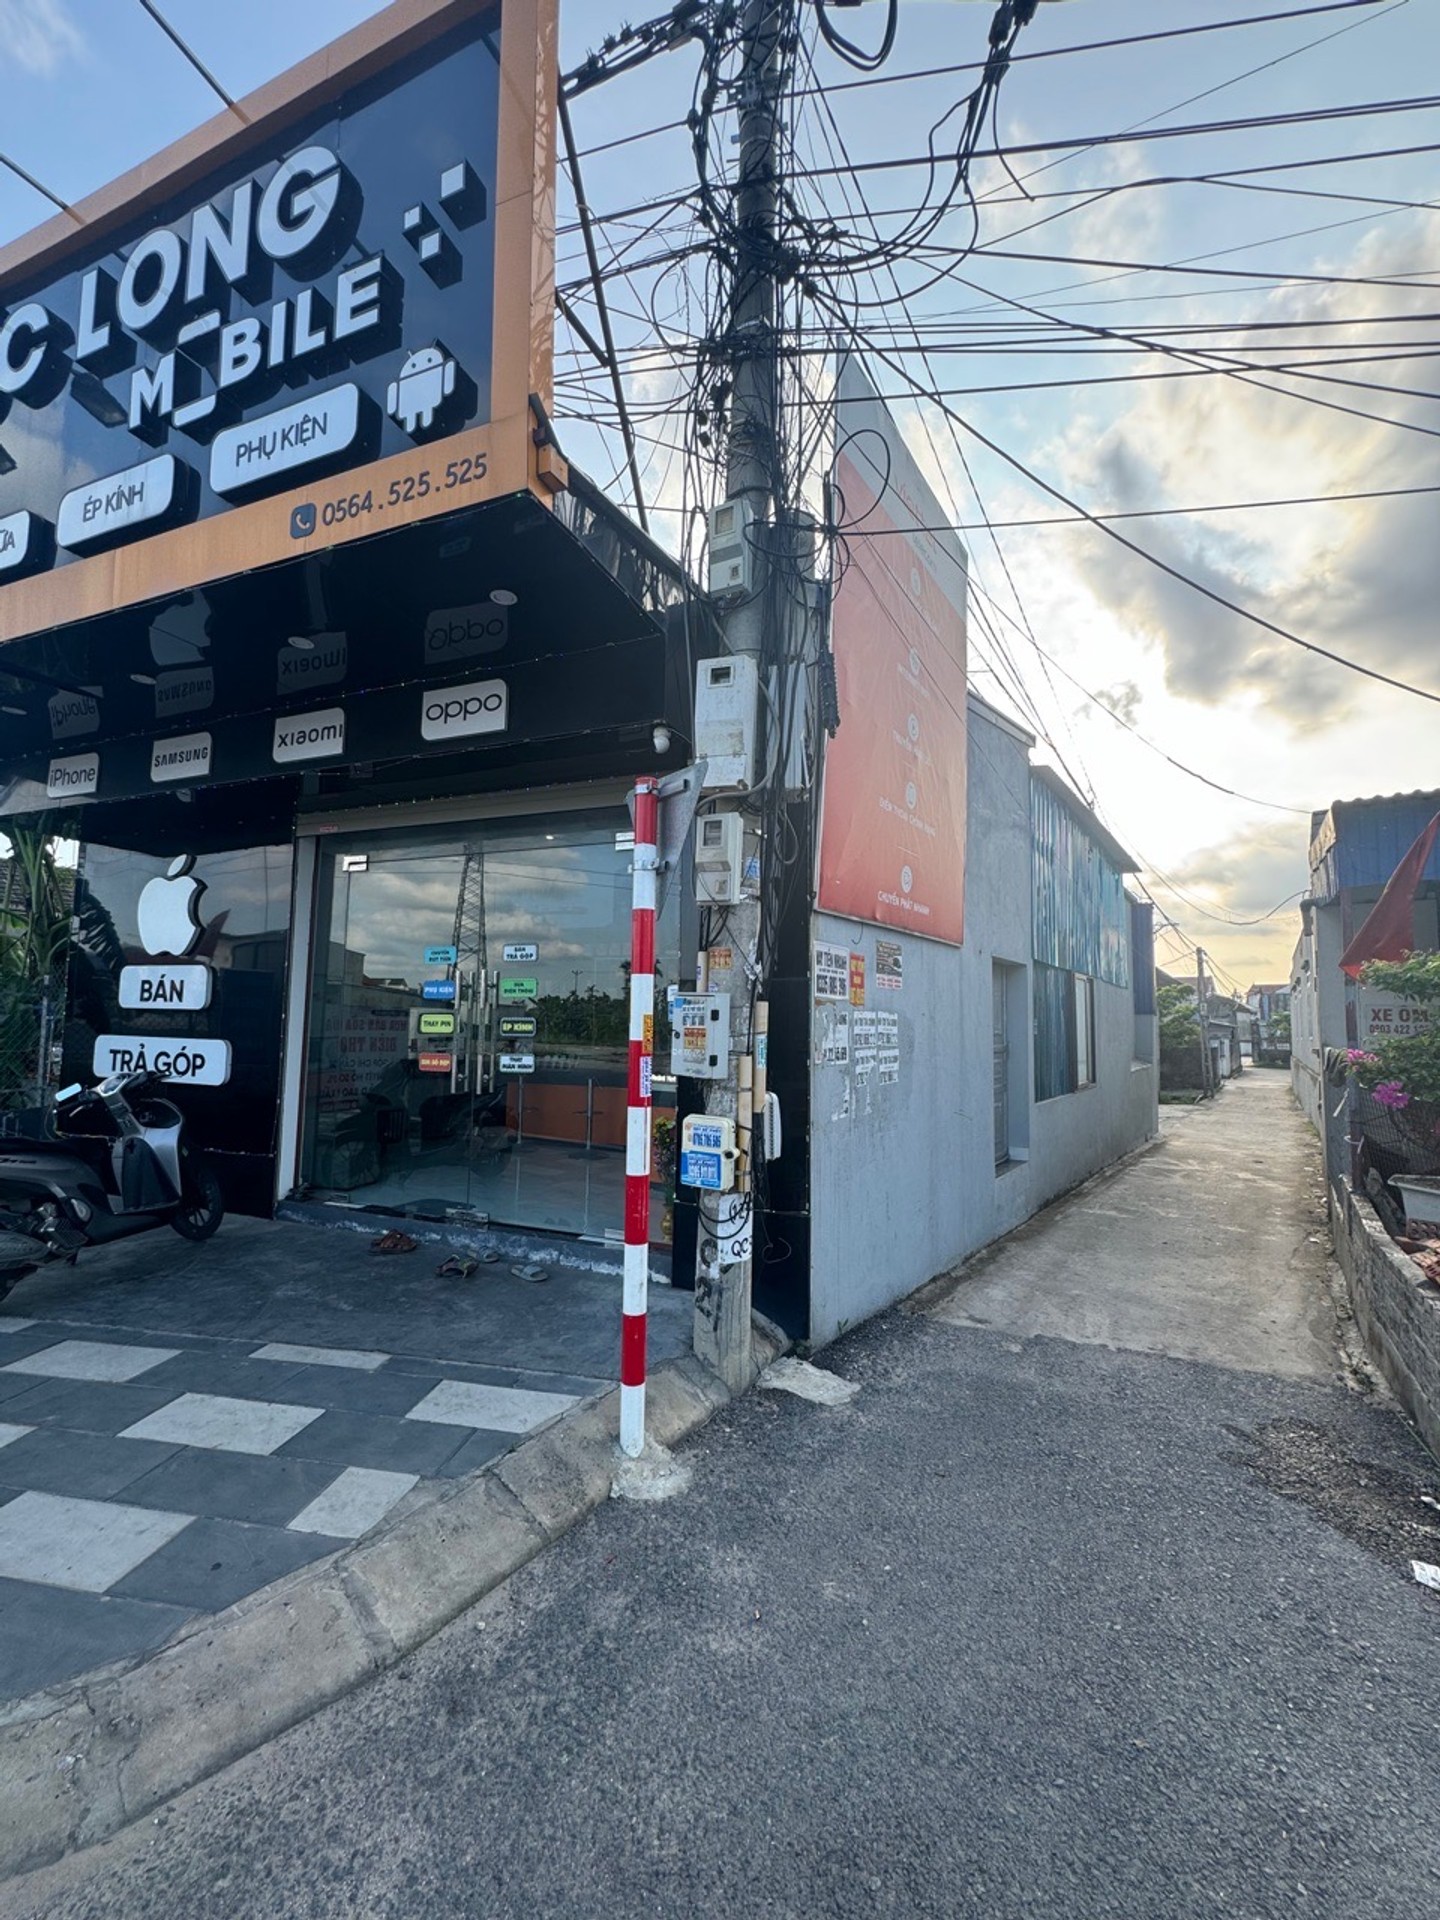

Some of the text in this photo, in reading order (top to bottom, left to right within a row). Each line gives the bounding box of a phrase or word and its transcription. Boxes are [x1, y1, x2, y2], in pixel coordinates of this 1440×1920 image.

[76, 146, 342, 362] LONG
[235, 412, 328, 467] PHỤ KIỆN
[82, 481, 145, 523] ÉP KÍNH
[322, 452, 488, 526] 0564.525.525
[425, 693, 502, 725] oppo
[277, 723, 344, 748] xiaomi
[154, 746, 208, 768] SAMSUNG
[50, 765, 96, 788] iPhone
[139, 973, 184, 1003] BÁN
[1371, 1008, 1393, 1022] XE
[109, 1042, 206, 1077] TRẢ GÓP
